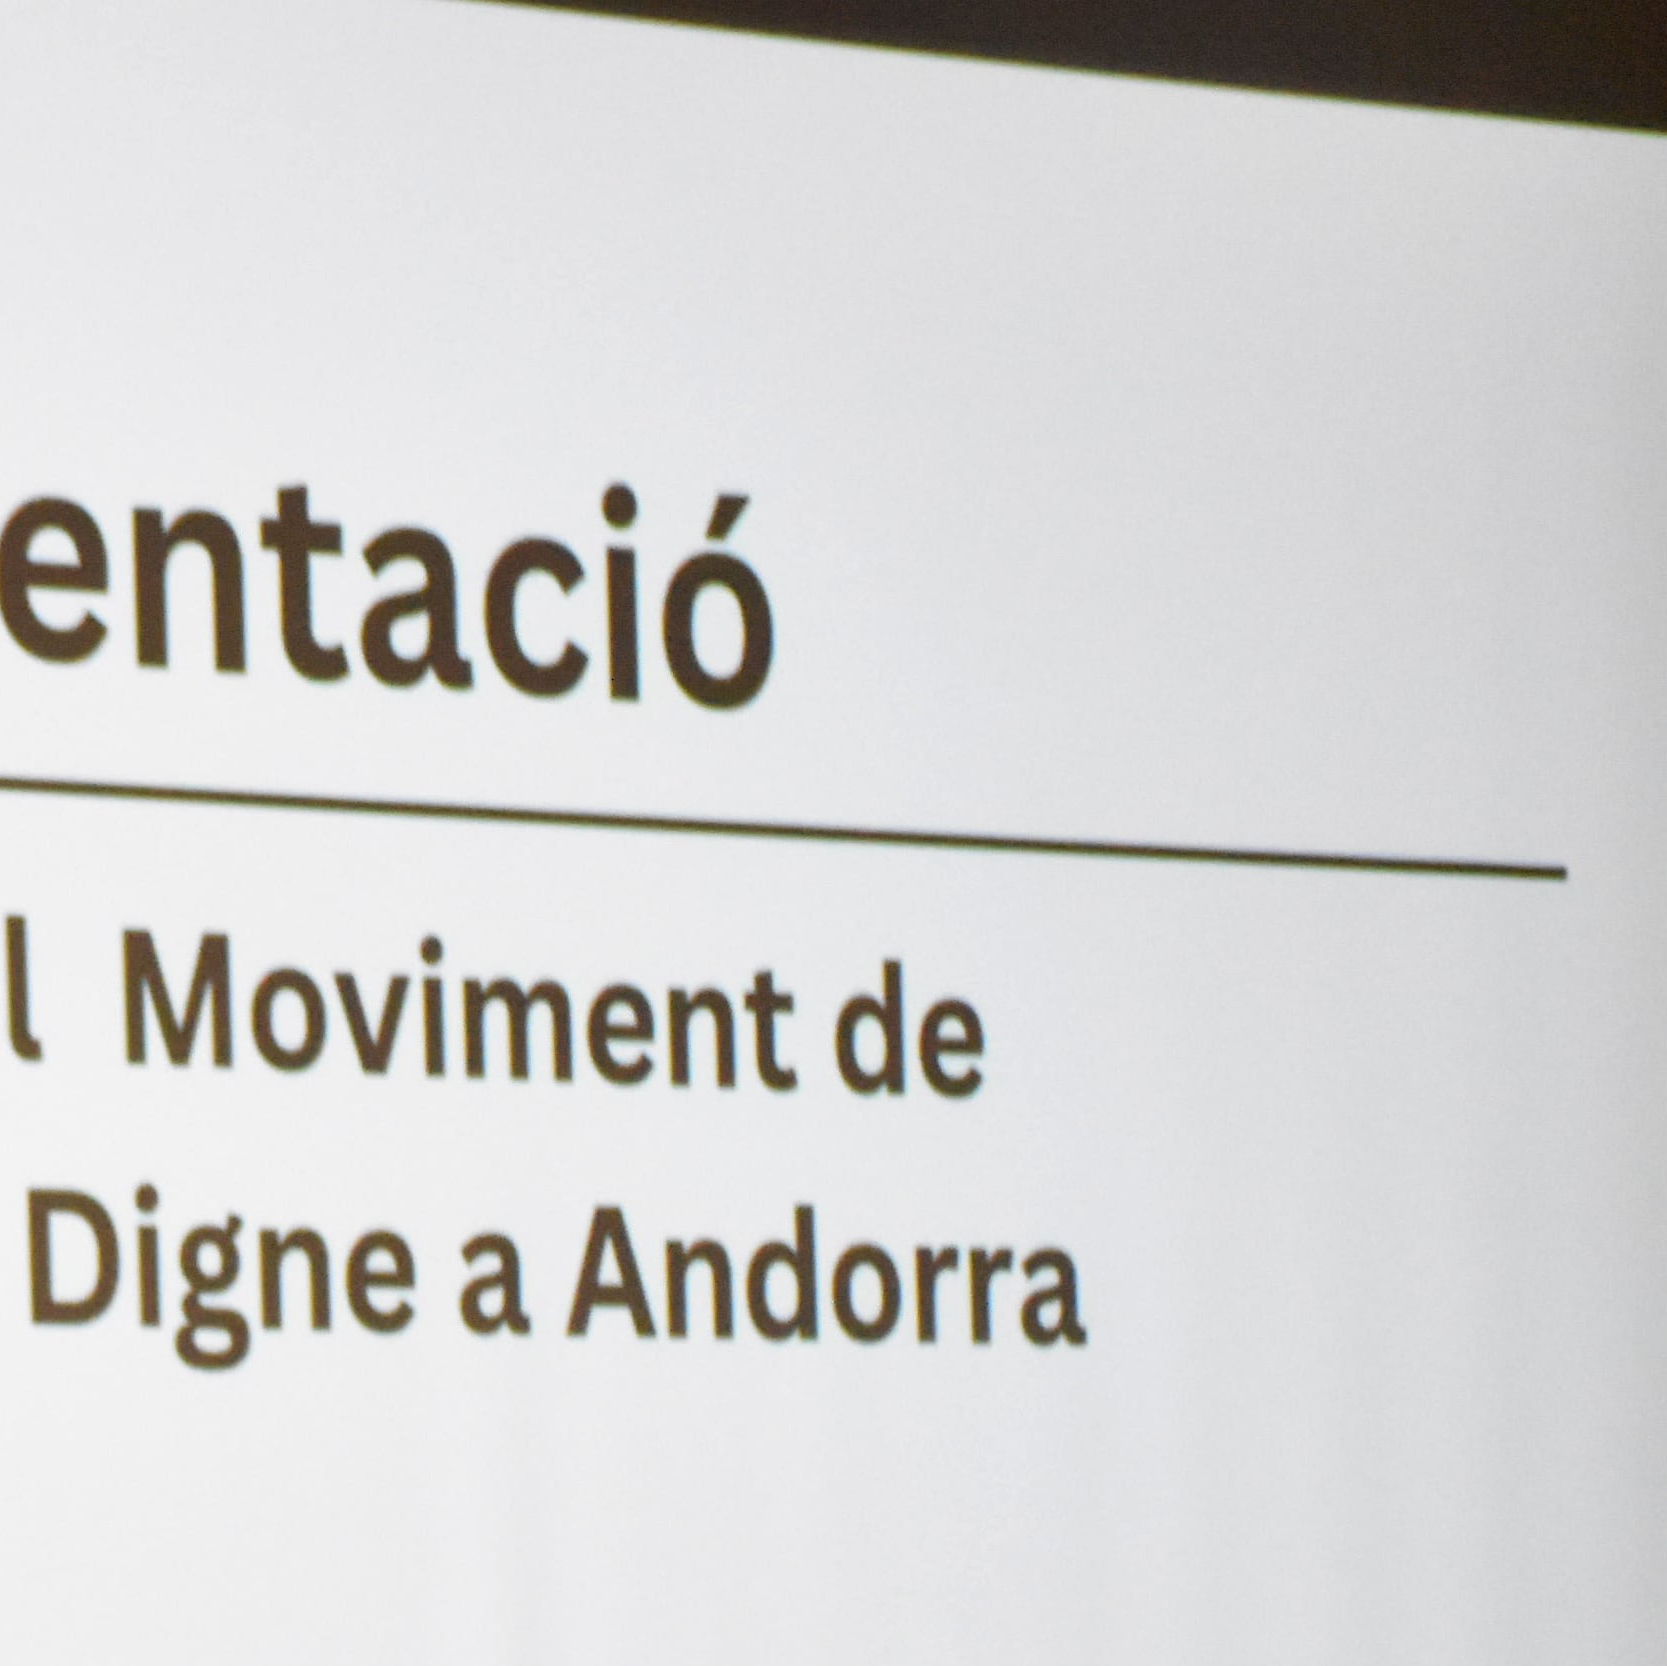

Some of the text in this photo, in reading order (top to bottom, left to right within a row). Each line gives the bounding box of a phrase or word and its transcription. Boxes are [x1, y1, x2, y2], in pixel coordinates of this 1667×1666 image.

[123, 930, 798, 1092] Moviment
[835, 960, 985, 1099] de
[28, 1184, 415, 1371] Digne
[460, 1233, 531, 1335] a
[568, 1205, 1087, 1347] Andorra
